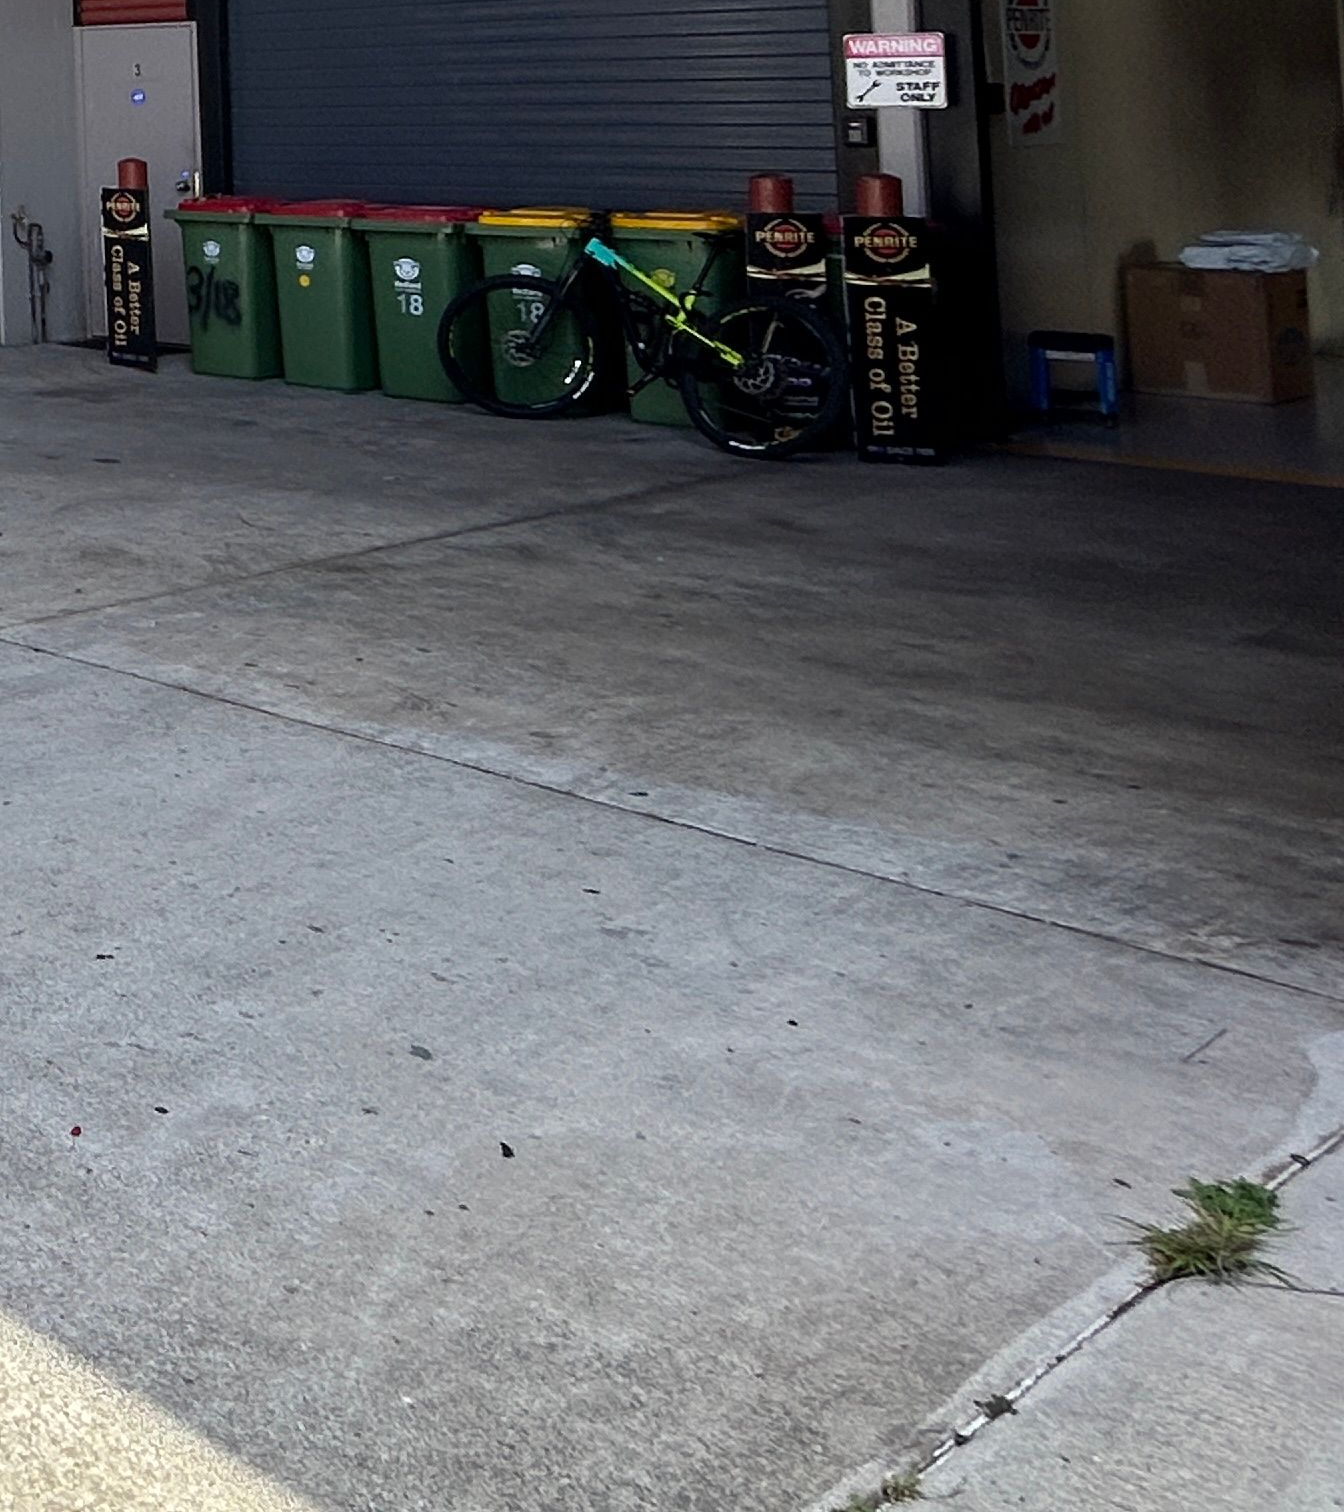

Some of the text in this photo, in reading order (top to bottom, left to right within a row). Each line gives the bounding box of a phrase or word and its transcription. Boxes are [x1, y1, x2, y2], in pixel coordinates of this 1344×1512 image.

[848, 37, 938, 55] WARNING
[134, 63, 142, 77] 3
[896, 81, 941, 92] STAFF
[900, 92, 937, 102] ONLY
[755, 230, 816, 244] PENRITE
[853, 236, 918, 249] PENRITE
[110, 245, 128, 347] Class of Oil
[127, 260, 142, 336] A Better
[396, 293, 424, 316] 18
[864, 296, 895, 436] Class of Oil
[895, 317, 921, 419] A Better
